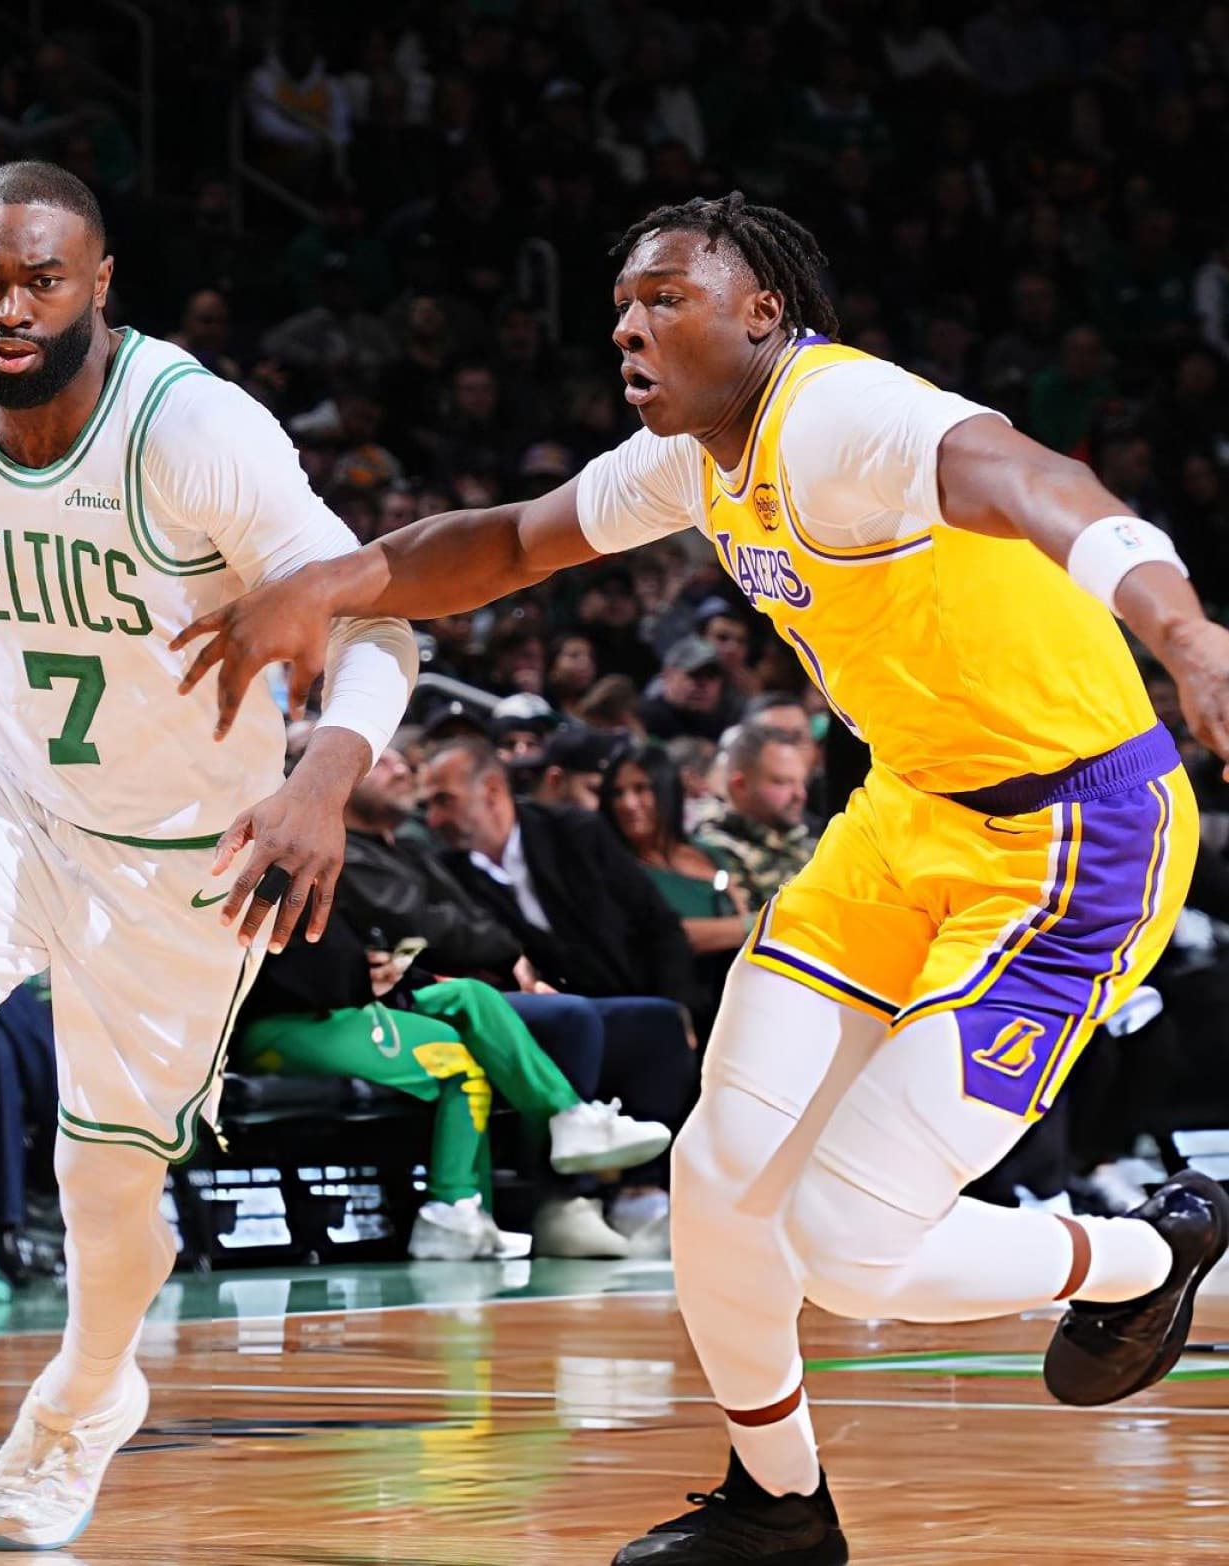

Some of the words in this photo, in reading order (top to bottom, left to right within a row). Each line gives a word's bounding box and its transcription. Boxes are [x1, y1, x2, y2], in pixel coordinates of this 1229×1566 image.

[65, 488, 121, 510] Amica
[715, 532, 812, 609] LAKERS
[22, 650, 107, 765] 7
